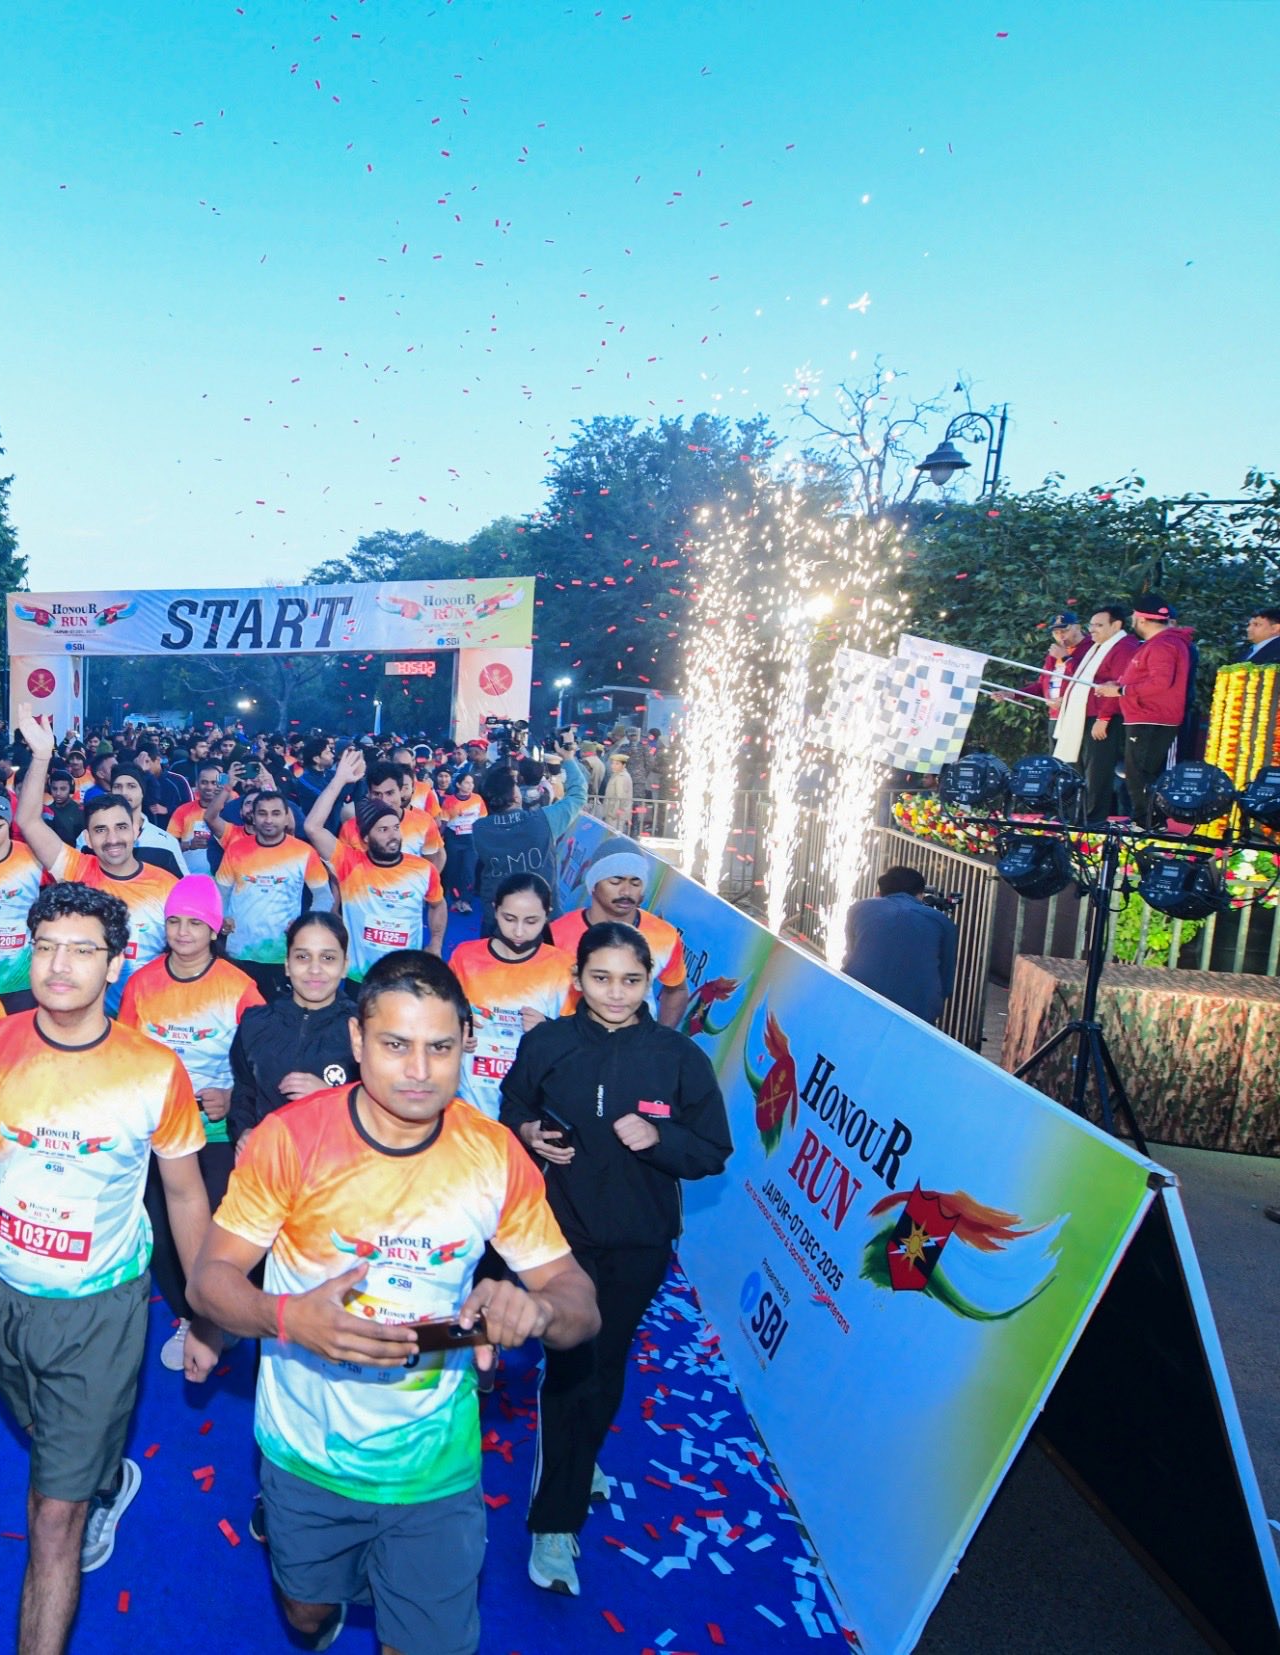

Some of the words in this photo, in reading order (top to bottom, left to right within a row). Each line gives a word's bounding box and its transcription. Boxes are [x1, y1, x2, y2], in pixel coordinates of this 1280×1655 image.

[423, 593, 476, 606] HONOUR
[52, 603, 97, 614] HONOUR
[433, 607, 467, 620] RUN
[61, 616, 88, 627] RUN
[160, 596, 354, 650] START
[373, 930, 400, 943] 11325
[800, 1053, 912, 1190] HONOUR
[36, 1126, 81, 1140] HONOUR
[45, 1138, 70, 1151] RUN
[788, 1128, 863, 1232] RUN
[13, 1219, 70, 1253] 10370
[378, 1235, 433, 1250] HONOUR
[387, 1247, 419, 1262] RUN
[799, 1227, 820, 1260] DEC
[816, 1251, 844, 1292] 2025
[397, 1278, 413, 1289] SBI
[379, 1307, 416, 1321] HONOUR
[751, 1291, 789, 1361] SBI
